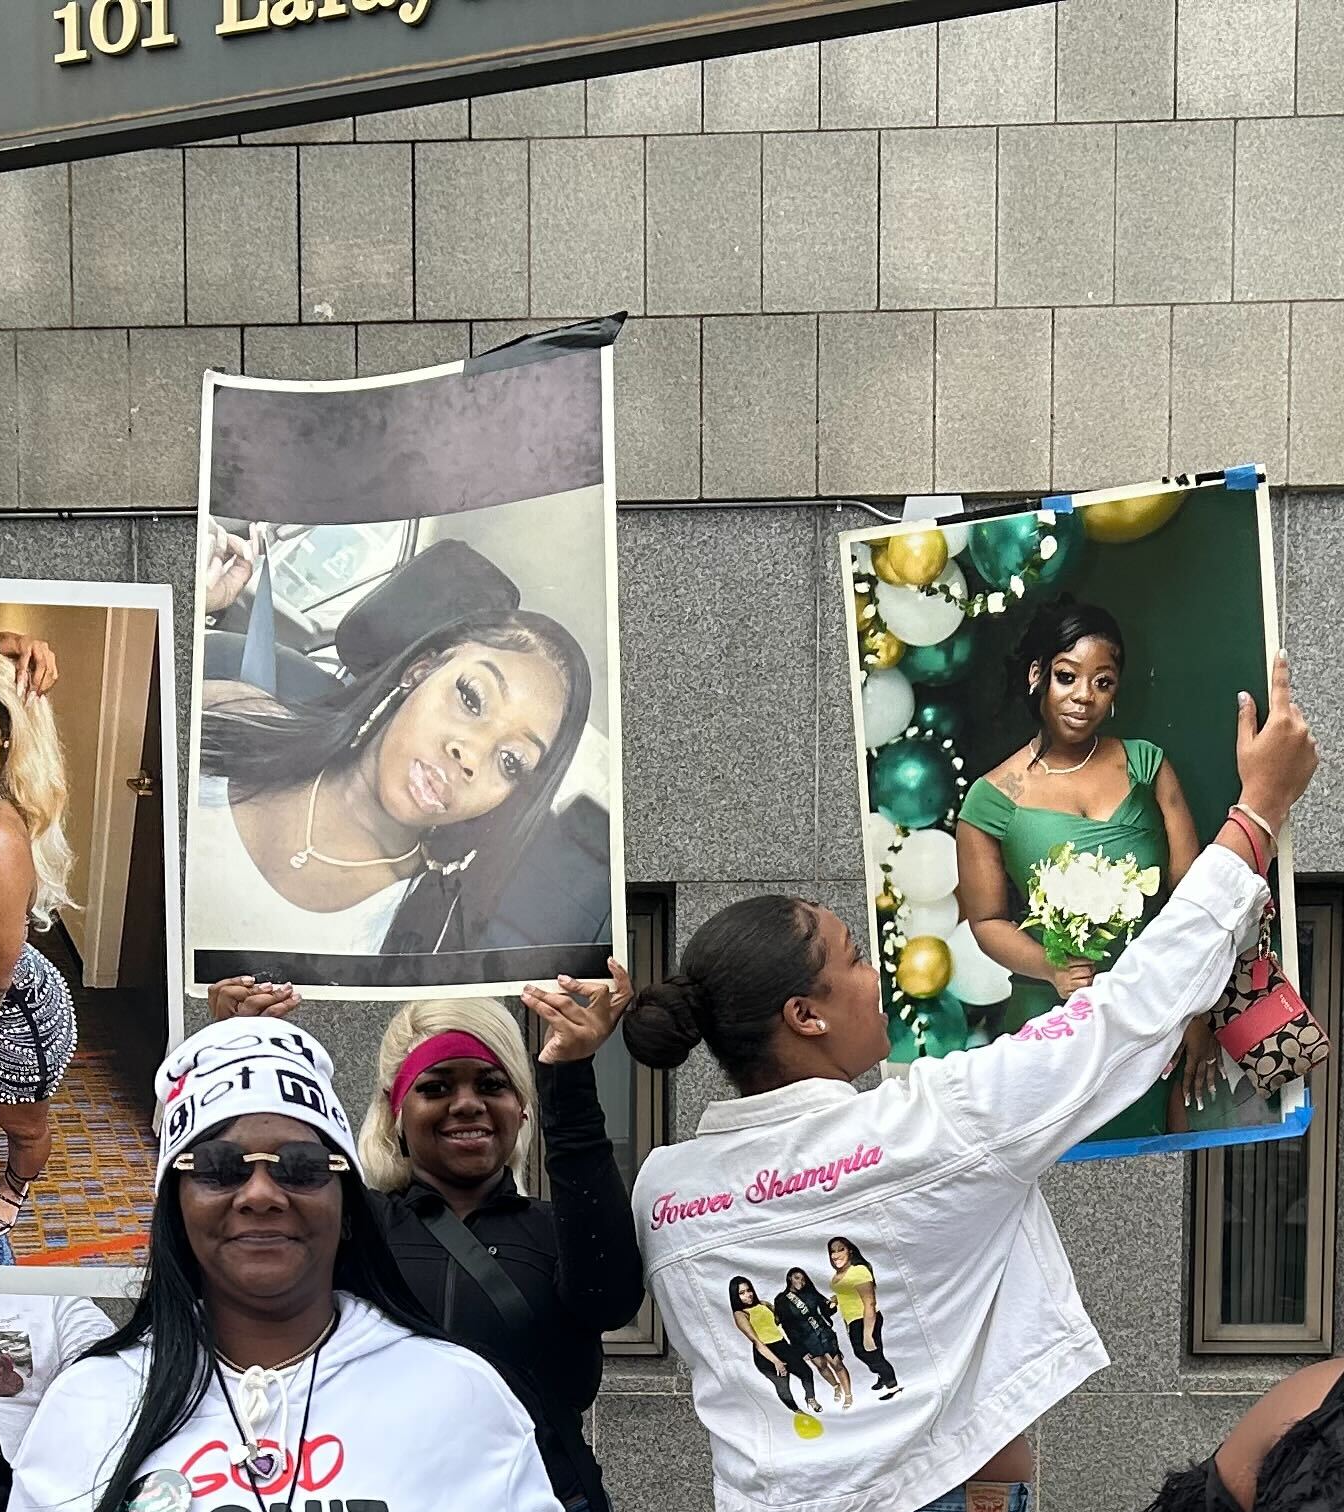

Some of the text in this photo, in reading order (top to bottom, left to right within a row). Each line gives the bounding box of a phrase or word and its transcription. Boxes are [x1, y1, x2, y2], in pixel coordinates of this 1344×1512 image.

[53, 0, 431, 65] 101 Lay
[651, 1143, 884, 1231] Forever Shamyria
[179, 1434, 344, 1498] GOD
